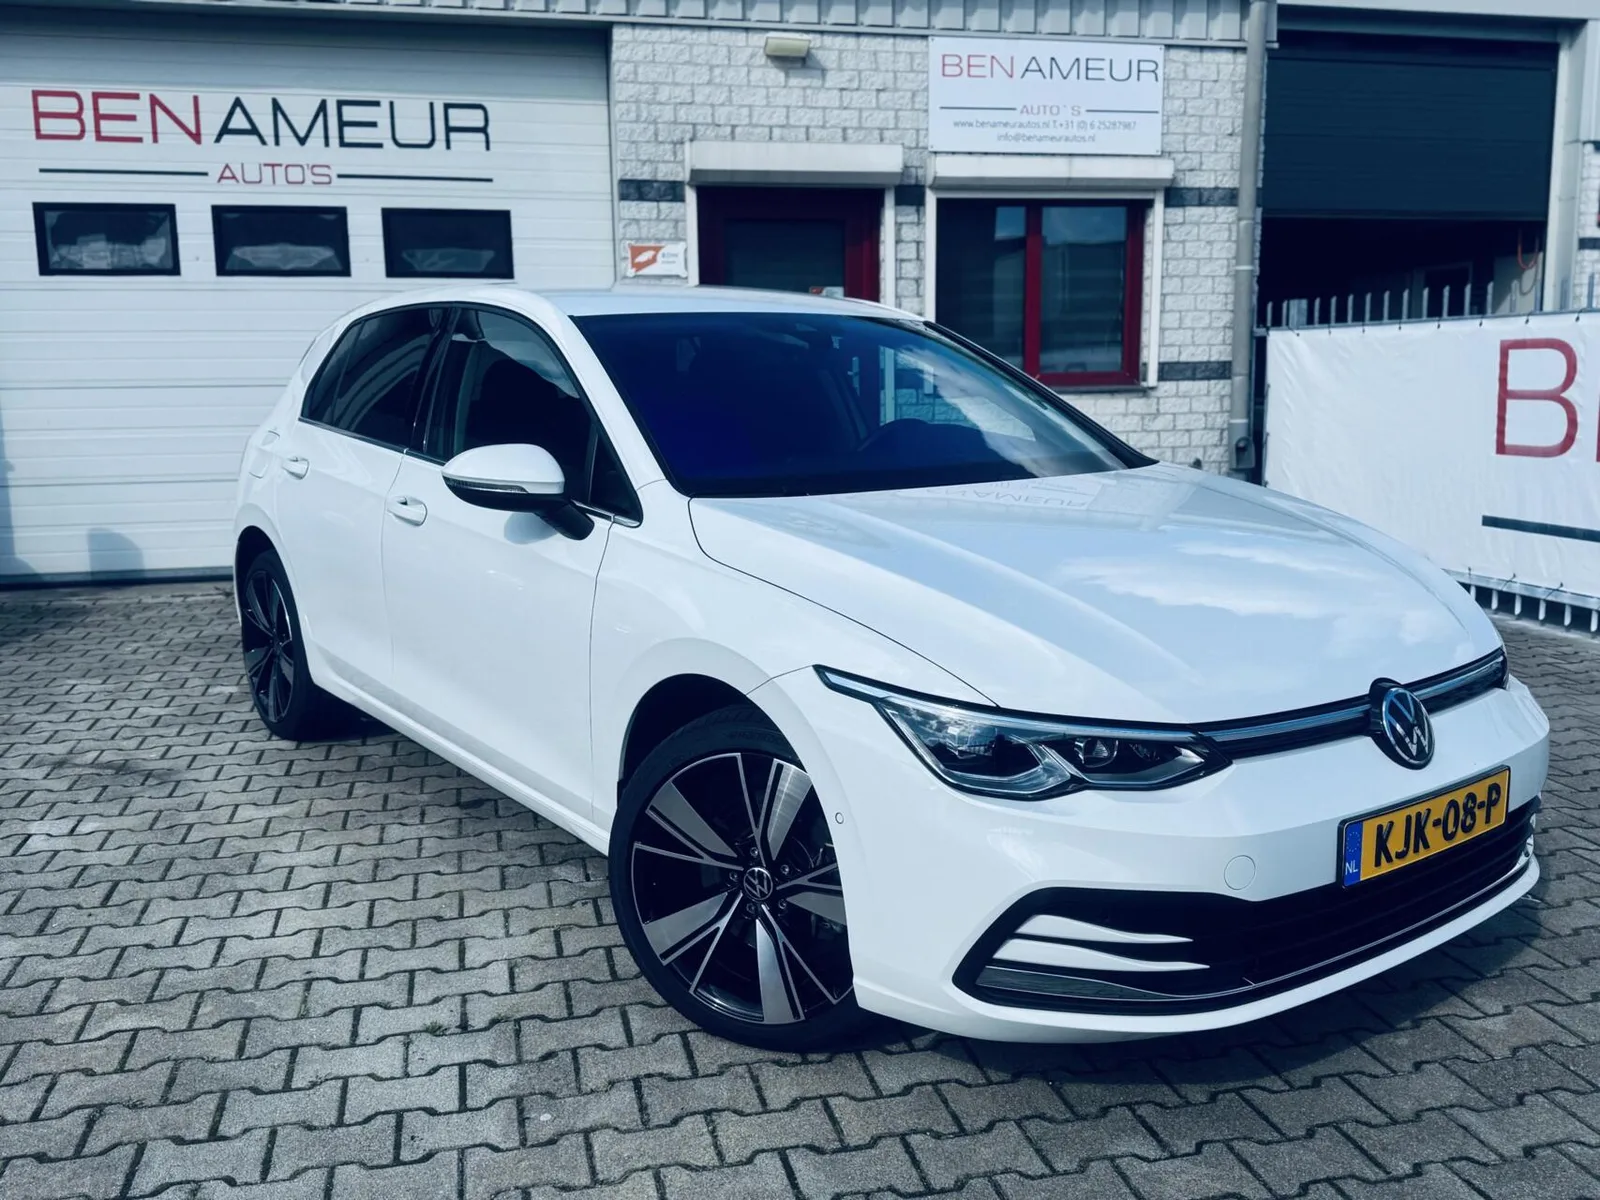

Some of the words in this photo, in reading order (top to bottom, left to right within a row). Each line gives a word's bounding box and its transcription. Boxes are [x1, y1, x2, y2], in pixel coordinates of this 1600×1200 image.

[941, 54, 1014, 79] BEN
[1020, 56, 1159, 82] AMEUR
[31, 89, 202, 145] BEN
[214, 96, 491, 151] AMEUR
[217, 162, 333, 185] AUTO'S
[1495, 337, 1600, 462] B
[1374, 783, 1501, 868] KJK-08-P
[1345, 862, 1359, 876] NL
